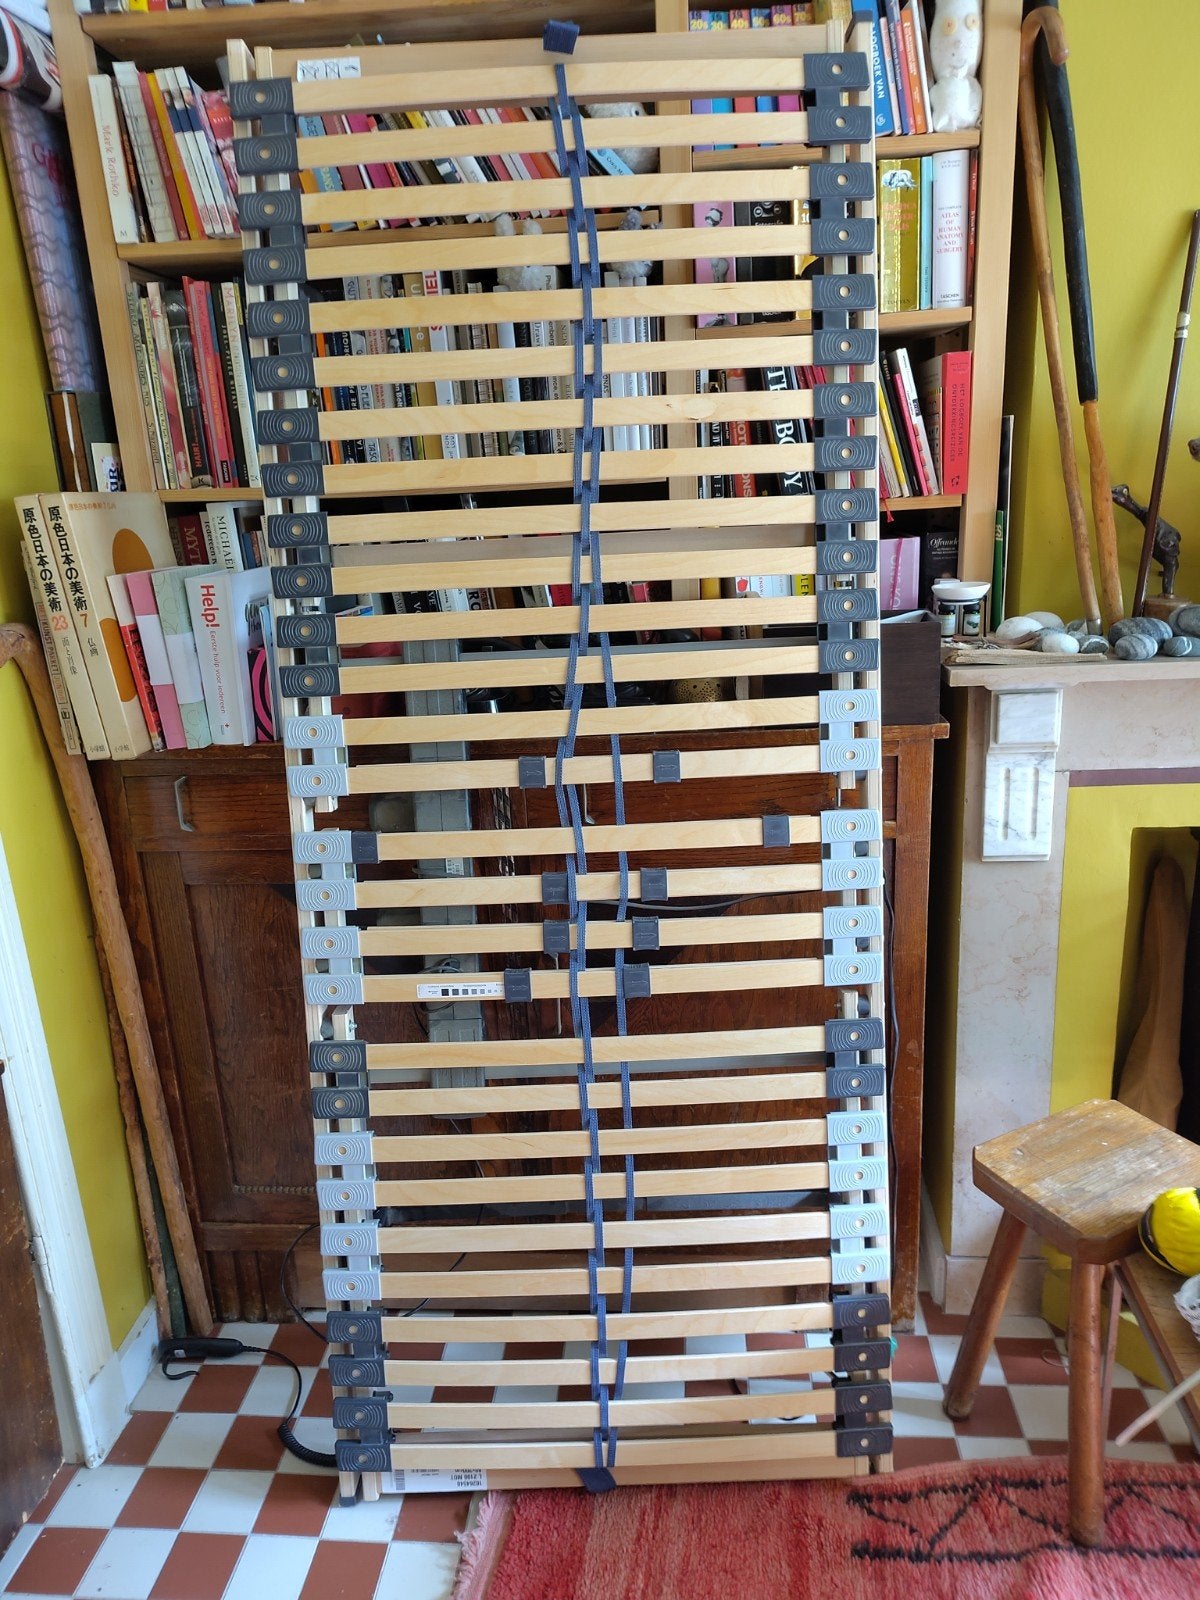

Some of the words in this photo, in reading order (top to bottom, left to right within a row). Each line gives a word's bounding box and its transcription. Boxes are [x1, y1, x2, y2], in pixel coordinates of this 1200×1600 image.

[877, 79, 885, 99] VAN
[102, 125, 112, 156] Mark
[107, 158, 119, 197] Rothko
[941, 211, 960, 219] ATLAS
[937, 232, 964, 241] ANATOMY
[22, 507, 62, 613] 原色日本の美術
[51, 615, 68, 631] 23
[48, 505, 88, 612] 原色日本の美術
[79, 613, 88, 628] 7
[200, 585, 220, 628] Help!
[41, 621, 51, 644] KUNST
[209, 630, 218, 653] Eerste
[217, 684, 226, 714] iedereen
